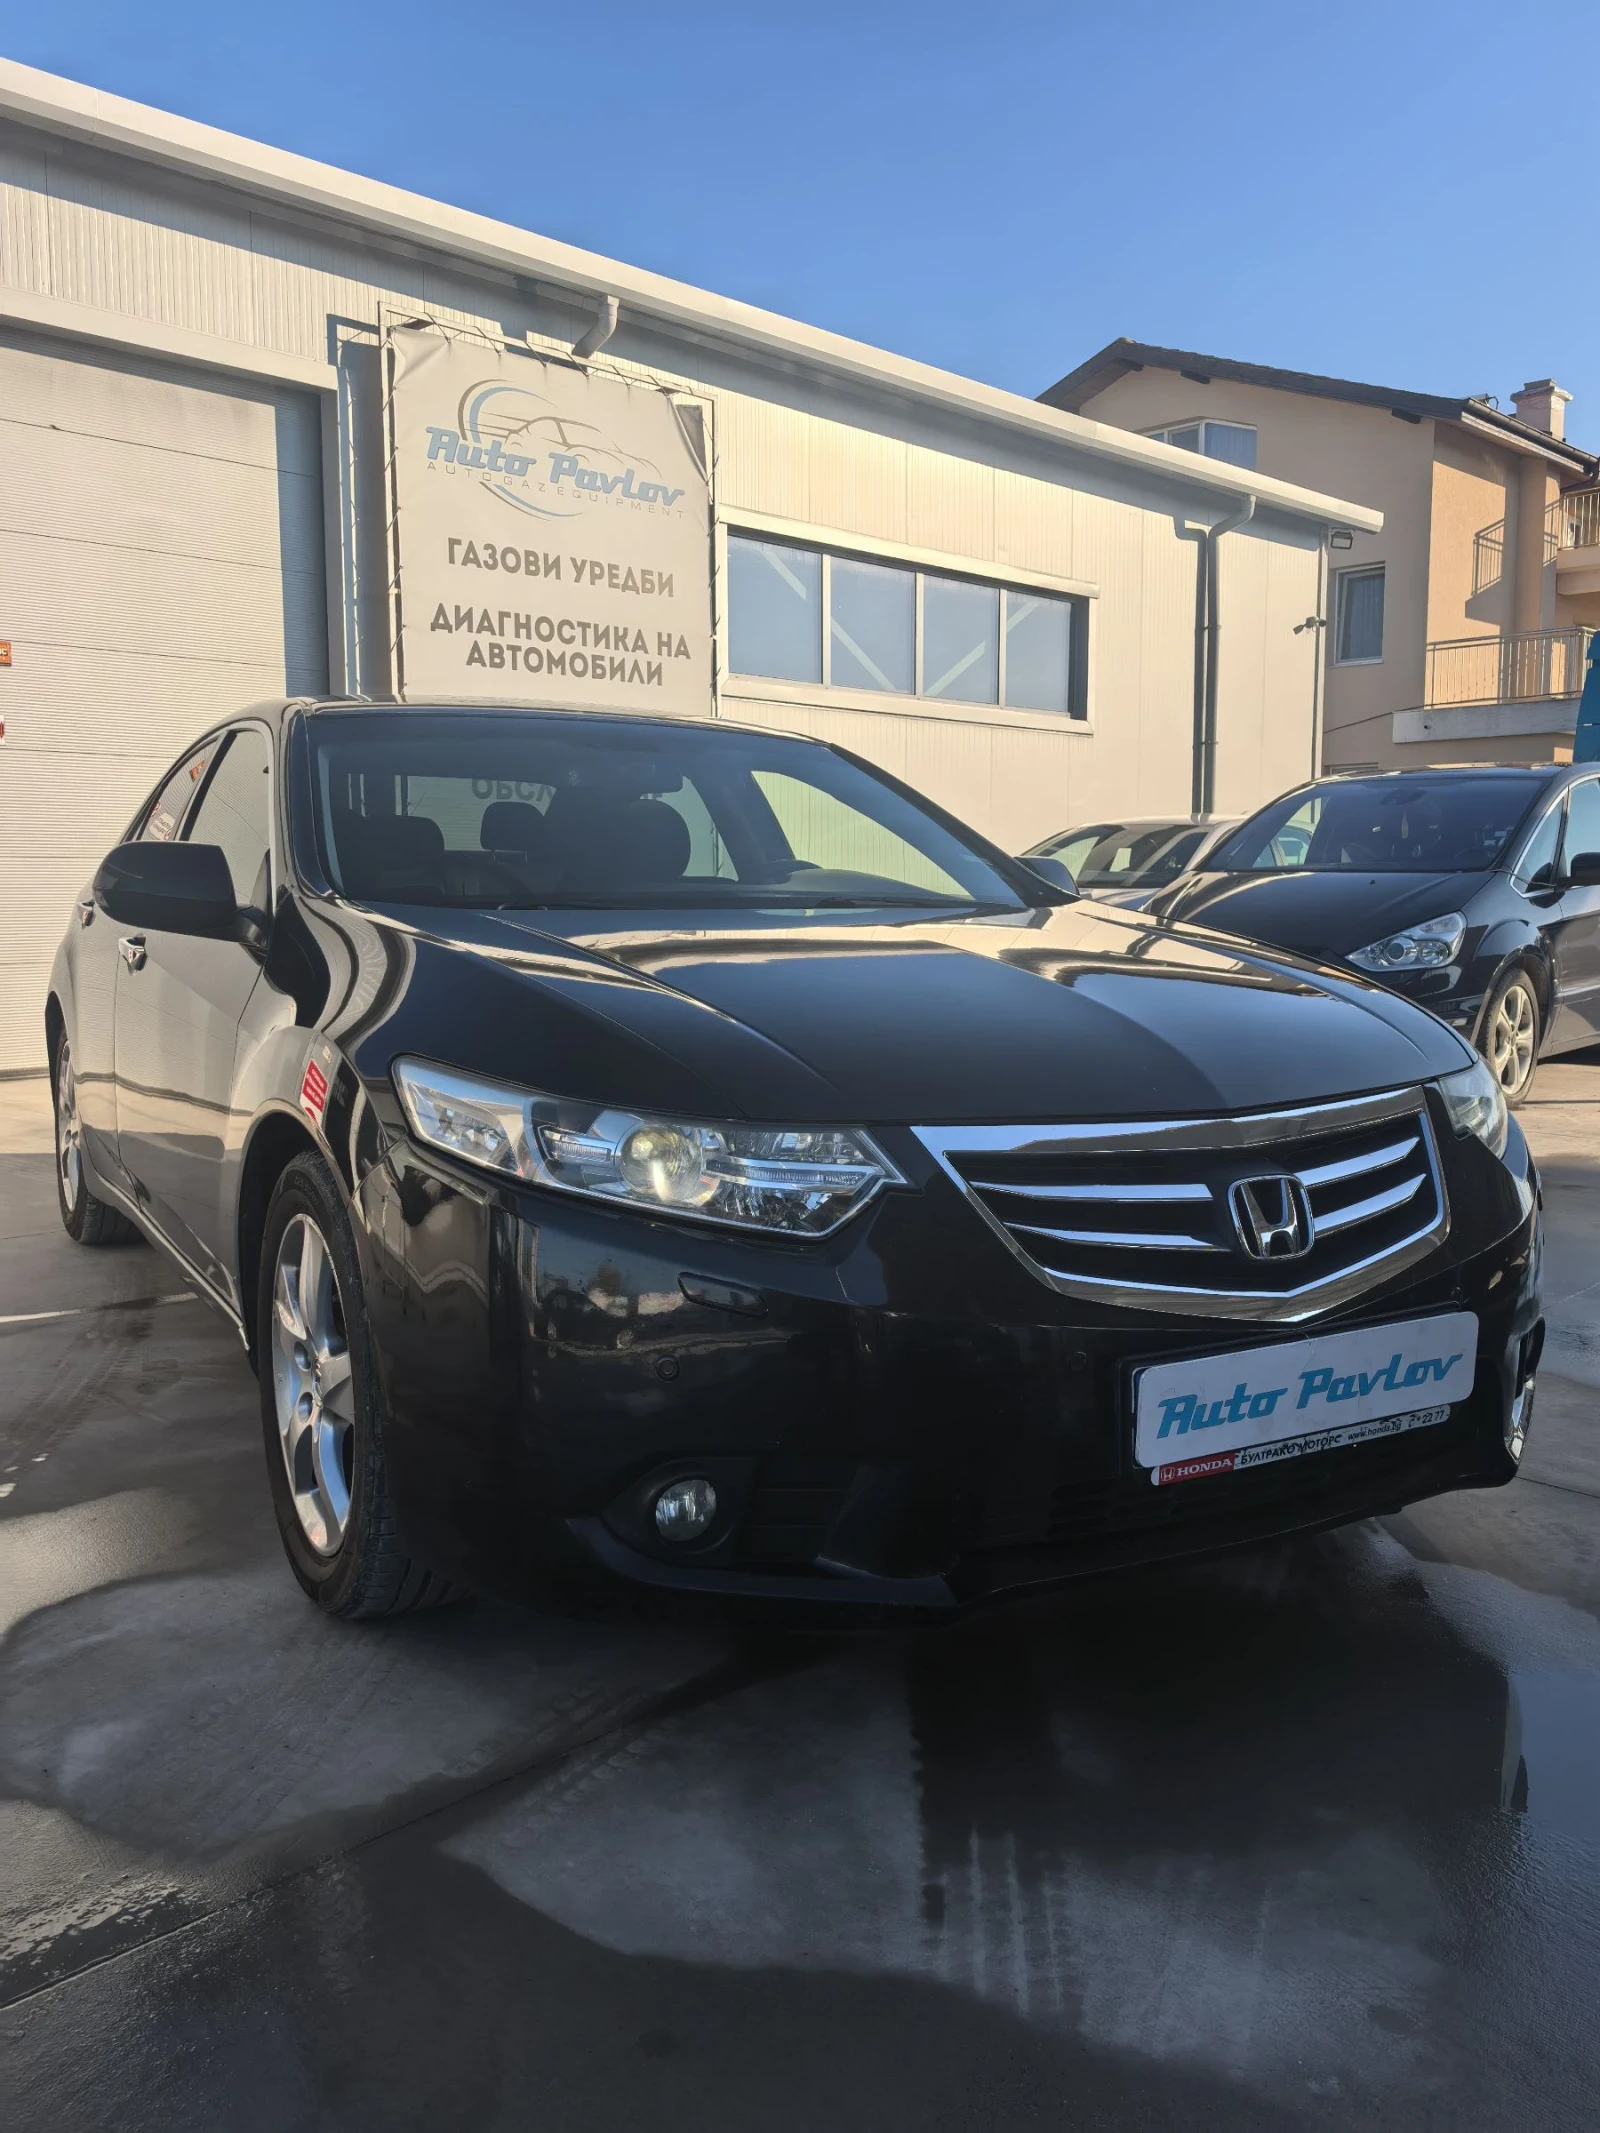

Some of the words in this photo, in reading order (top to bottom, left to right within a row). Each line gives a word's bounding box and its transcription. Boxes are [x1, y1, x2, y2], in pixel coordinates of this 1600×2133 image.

[426, 426, 537, 476] Auto
[548, 452, 685, 506] Pavlov
[448, 537, 562, 581] ГАЗОВИ
[569, 556, 674, 598] УРЕДБИ
[430, 602, 649, 655] ДИАГНОСТИКА
[657, 631, 692, 660] НА
[465, 639, 663, 686] АВТОМОБИЛИ
[1156, 1382, 1289, 1439] Auto
[1296, 1353, 1464, 1410] Pavlov
[1176, 1457, 1233, 1477] HONDA
